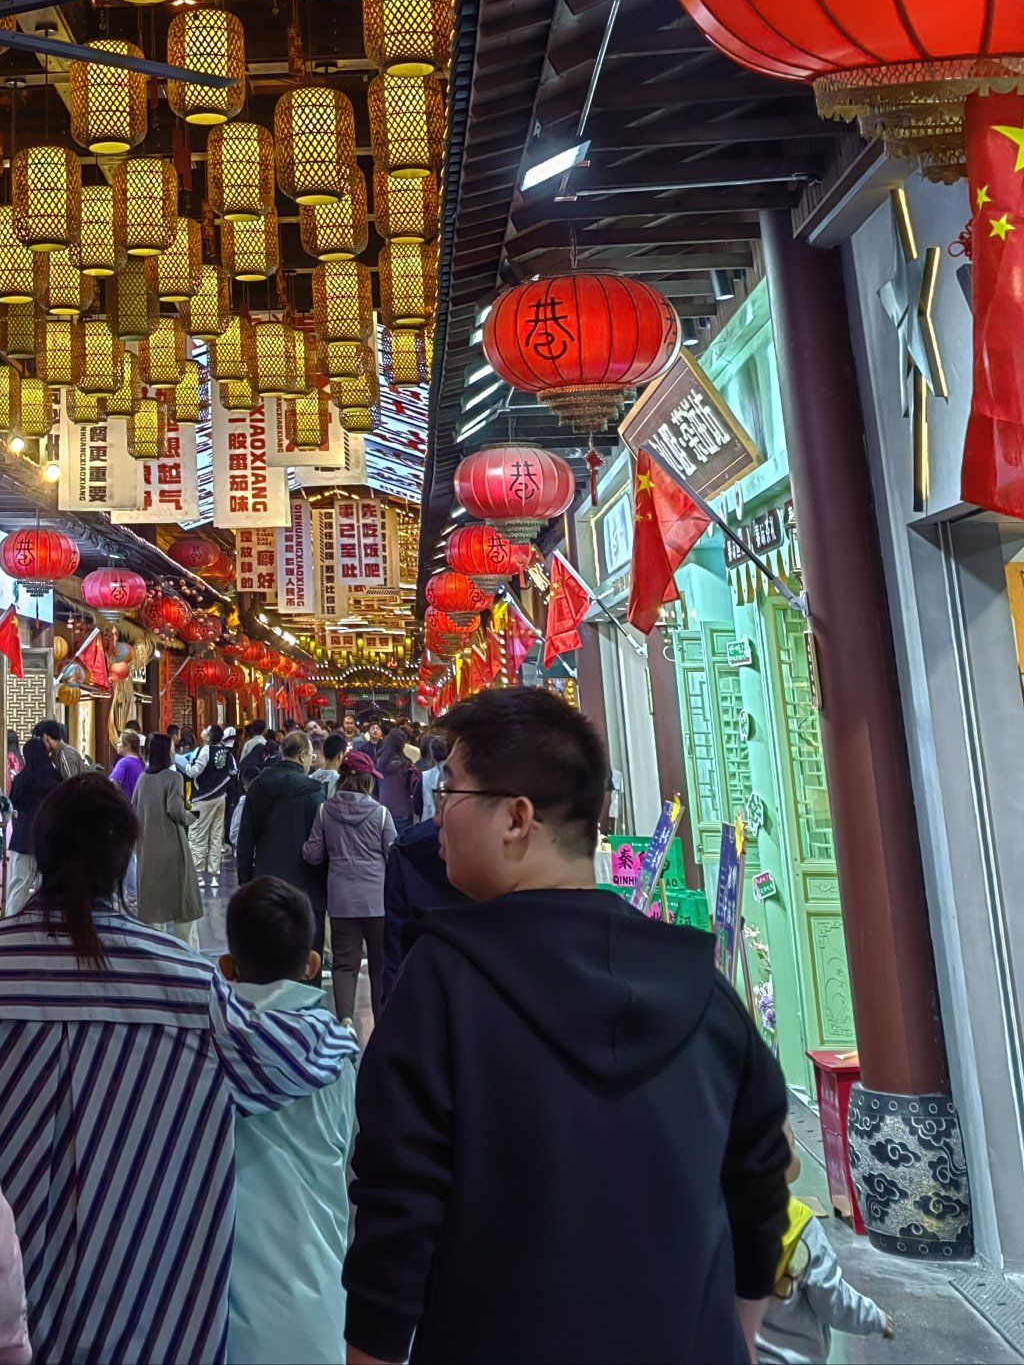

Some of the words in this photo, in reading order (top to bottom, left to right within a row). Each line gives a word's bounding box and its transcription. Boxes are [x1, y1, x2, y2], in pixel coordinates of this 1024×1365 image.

[228, 417, 249, 513] 一股番茄味
[338, 502, 358, 579] 事已至此
[361, 502, 381, 578] 先吃饭吧
